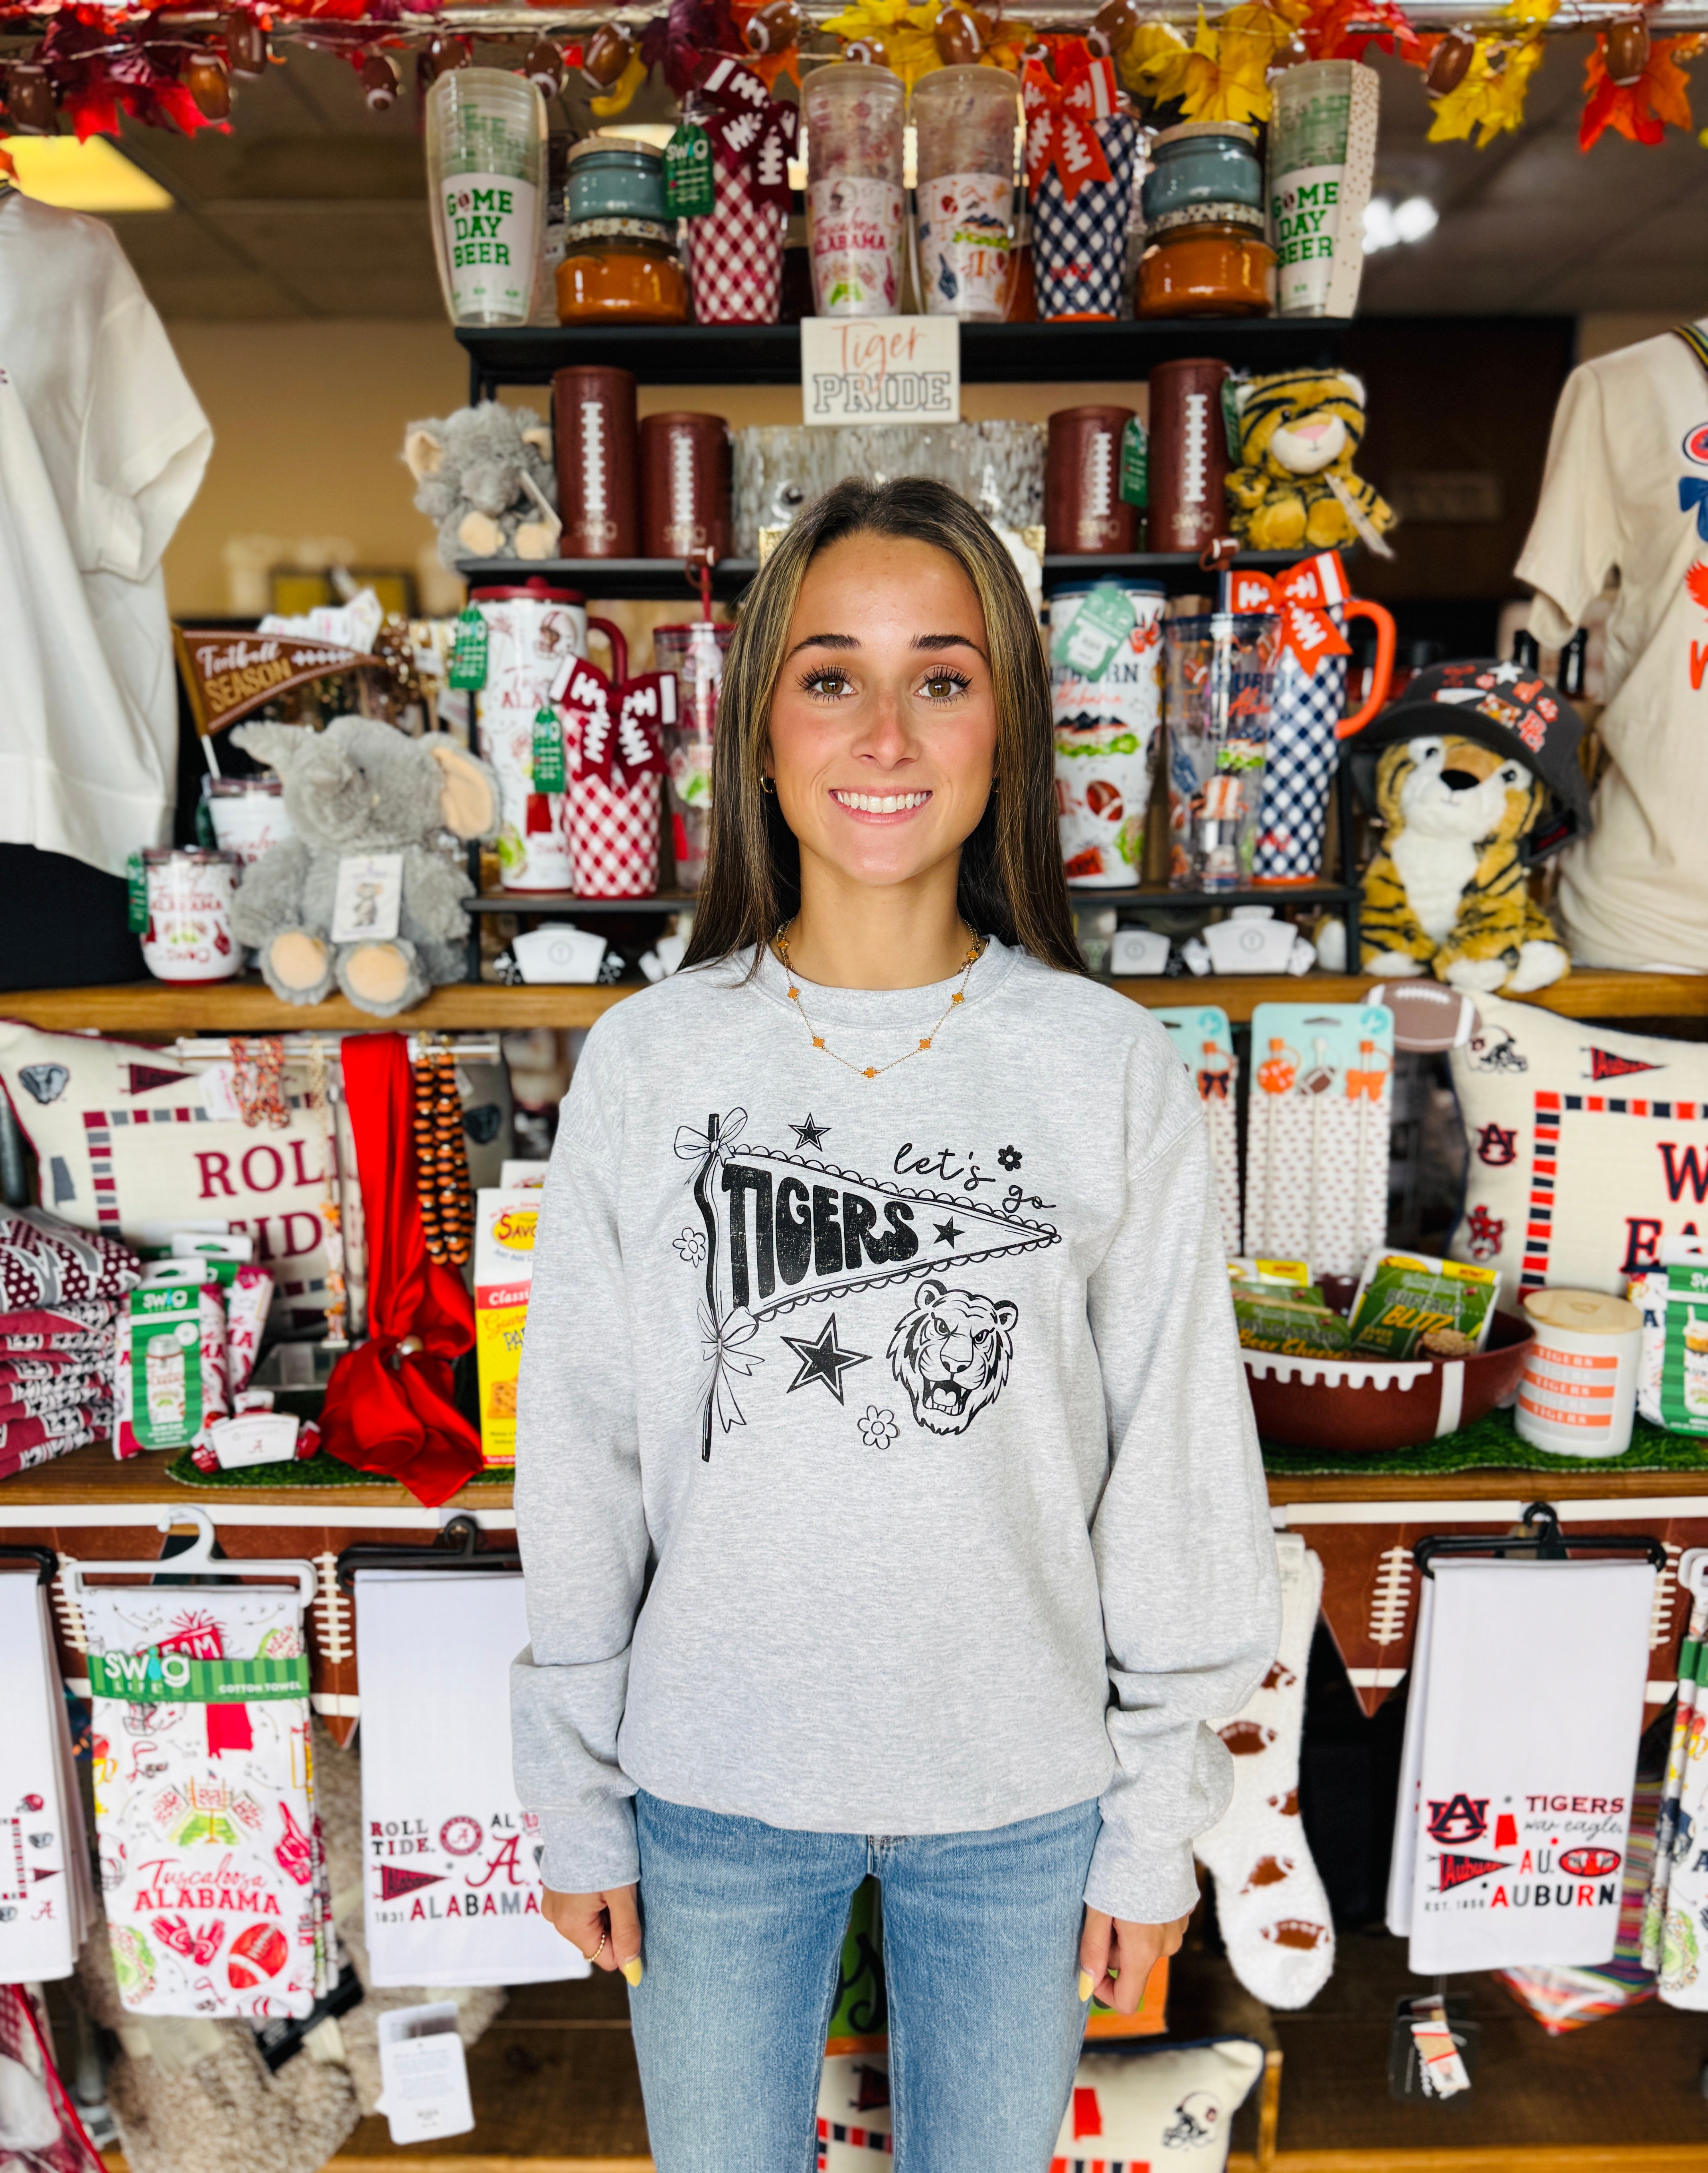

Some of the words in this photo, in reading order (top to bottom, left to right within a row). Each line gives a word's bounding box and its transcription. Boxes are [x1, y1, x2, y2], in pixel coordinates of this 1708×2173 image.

[446, 189, 513, 217] GME
[1274, 181, 1339, 220] GME
[455, 216, 502, 241] DAY
[1279, 210, 1327, 241] DAY
[454, 243, 510, 268] BEER
[1278, 237, 1333, 270] BEER
[832, 322, 928, 395] Tiger
[814, 372, 951, 413] PRIDE
[196, 640, 282, 679] Football
[204, 657, 292, 713] SEASON
[894, 1143, 995, 1191] let's
[1002, 1184, 1057, 1213] go
[721, 1162, 919, 1309] TIGERS
[1385, 1288, 1466, 1316] BUFFALO
[1381, 1304, 1455, 1334] BLITZ
[1239, 1329, 1278, 1351] Beer
[1538, 1347, 1593, 1368] TIGERS
[1536, 1376, 1590, 1395] TIGERS
[1533, 1404, 1587, 1423] TIGERS
[115, 1680, 160, 1694] LIFE
[219, 1684, 263, 1694] COTTON
[265, 1682, 302, 1692] TOWEL
[1525, 1795, 1624, 1814] TIGERS
[371, 1819, 428, 1836] ROLL
[491, 1814, 514, 1828] AL
[1524, 1820, 1556, 1830] war
[371, 1838, 429, 1855] TIDE
[465, 1834, 525, 1887] A
[137, 1852, 267, 1891] Tuscaloosa
[1443, 1855, 1504, 1889] Auburn
[134, 1889, 282, 1916] ALABAMA
[411, 1891, 540, 1921] ALABAMA
[1491, 1884, 1615, 1908] AUBURN
